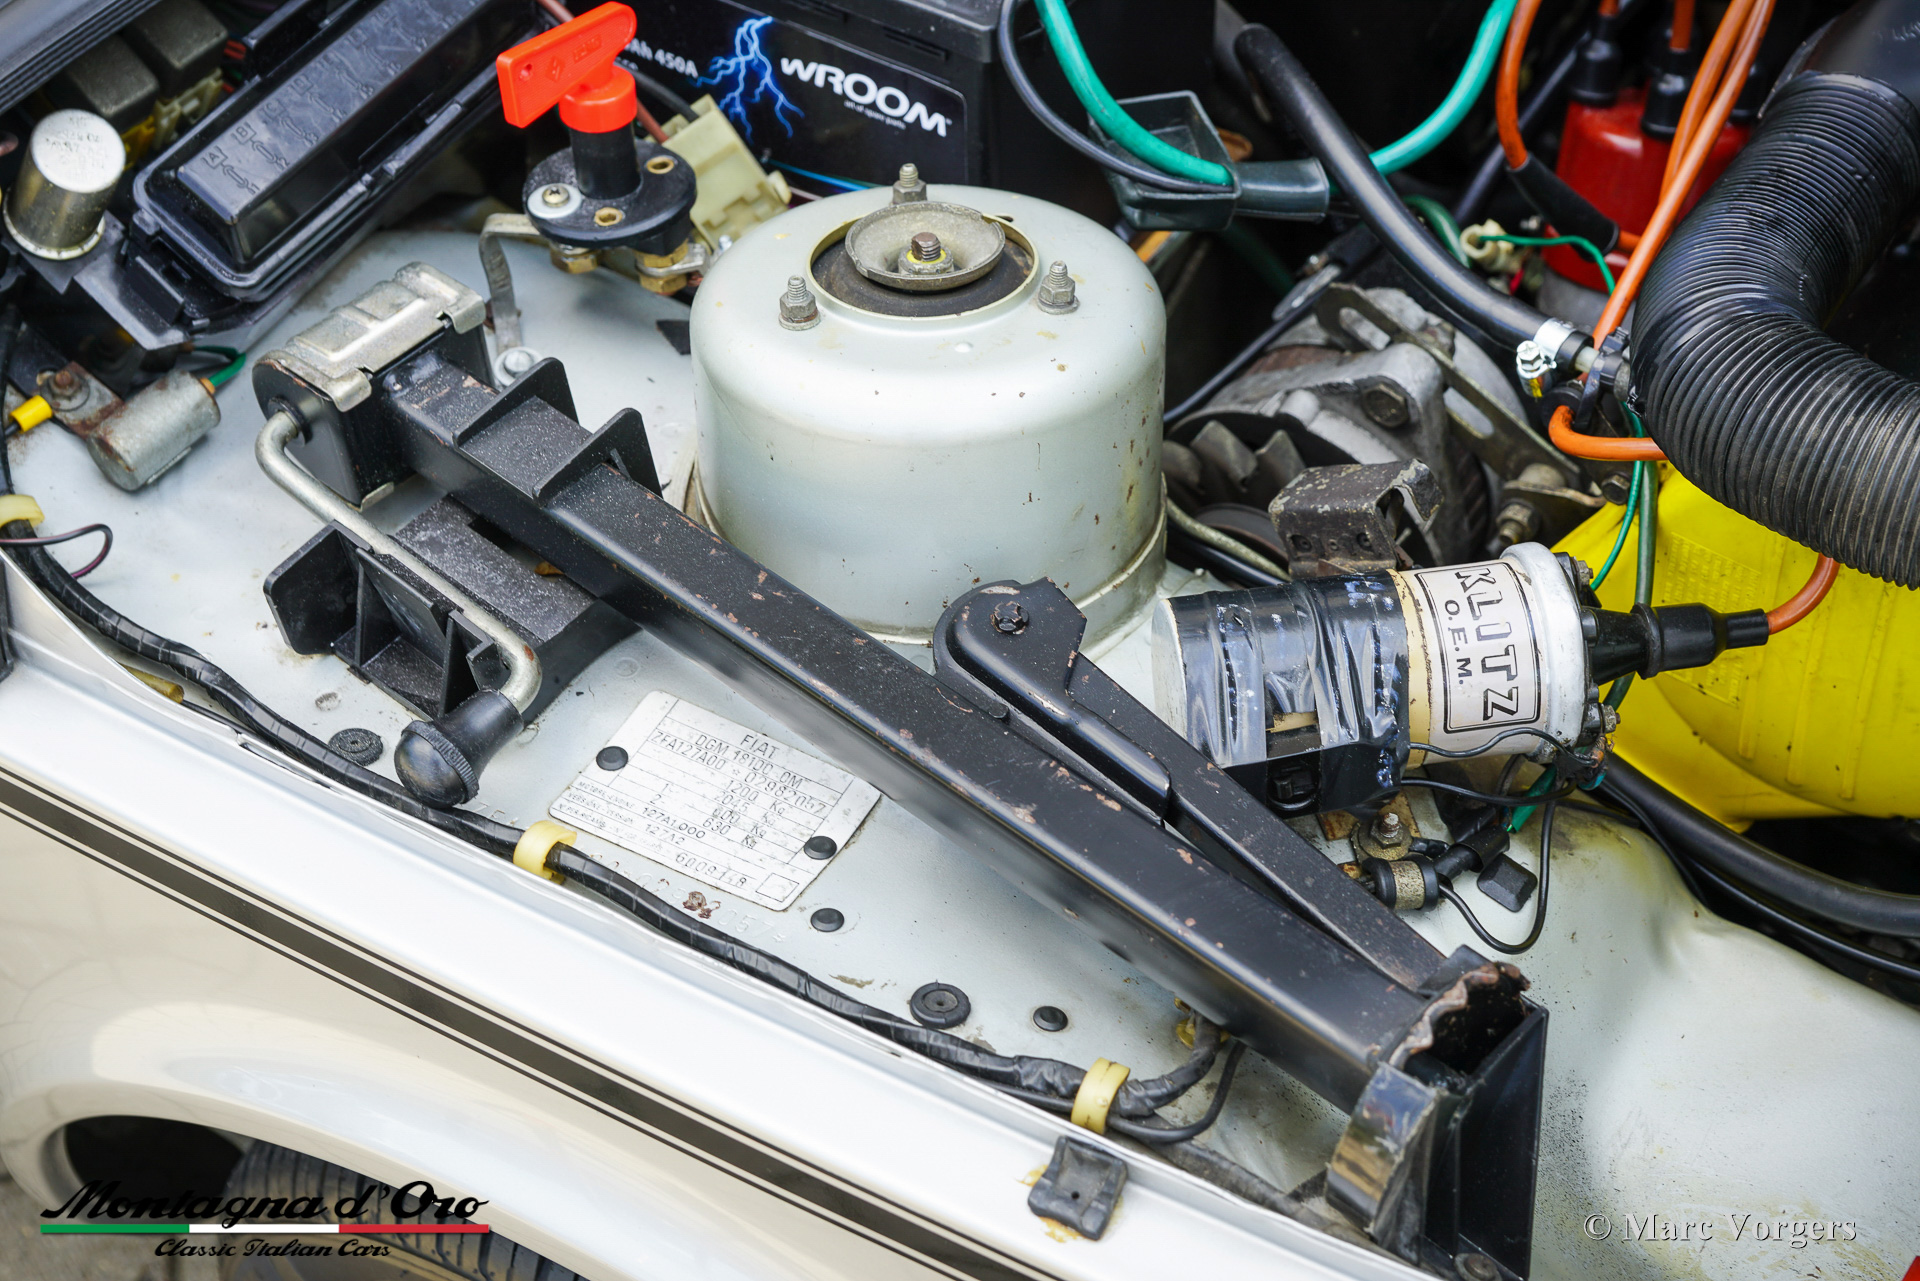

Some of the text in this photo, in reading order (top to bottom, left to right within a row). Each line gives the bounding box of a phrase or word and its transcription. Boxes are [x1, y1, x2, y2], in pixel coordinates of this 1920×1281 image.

[654, 48, 700, 78] 450A
[780, 57, 948, 137] WROOM
[208, 152, 220, 163] A
[1454, 567, 1519, 721] KLITZ
[695, 733, 730, 756] DGM
[740, 733, 780, 760] FIAT
[651, 730, 827, 816] ZFA127A00 02982057
[714, 790, 750, 813] 2045
[725, 779, 760, 802] 1200
[702, 817, 731, 836] 630
